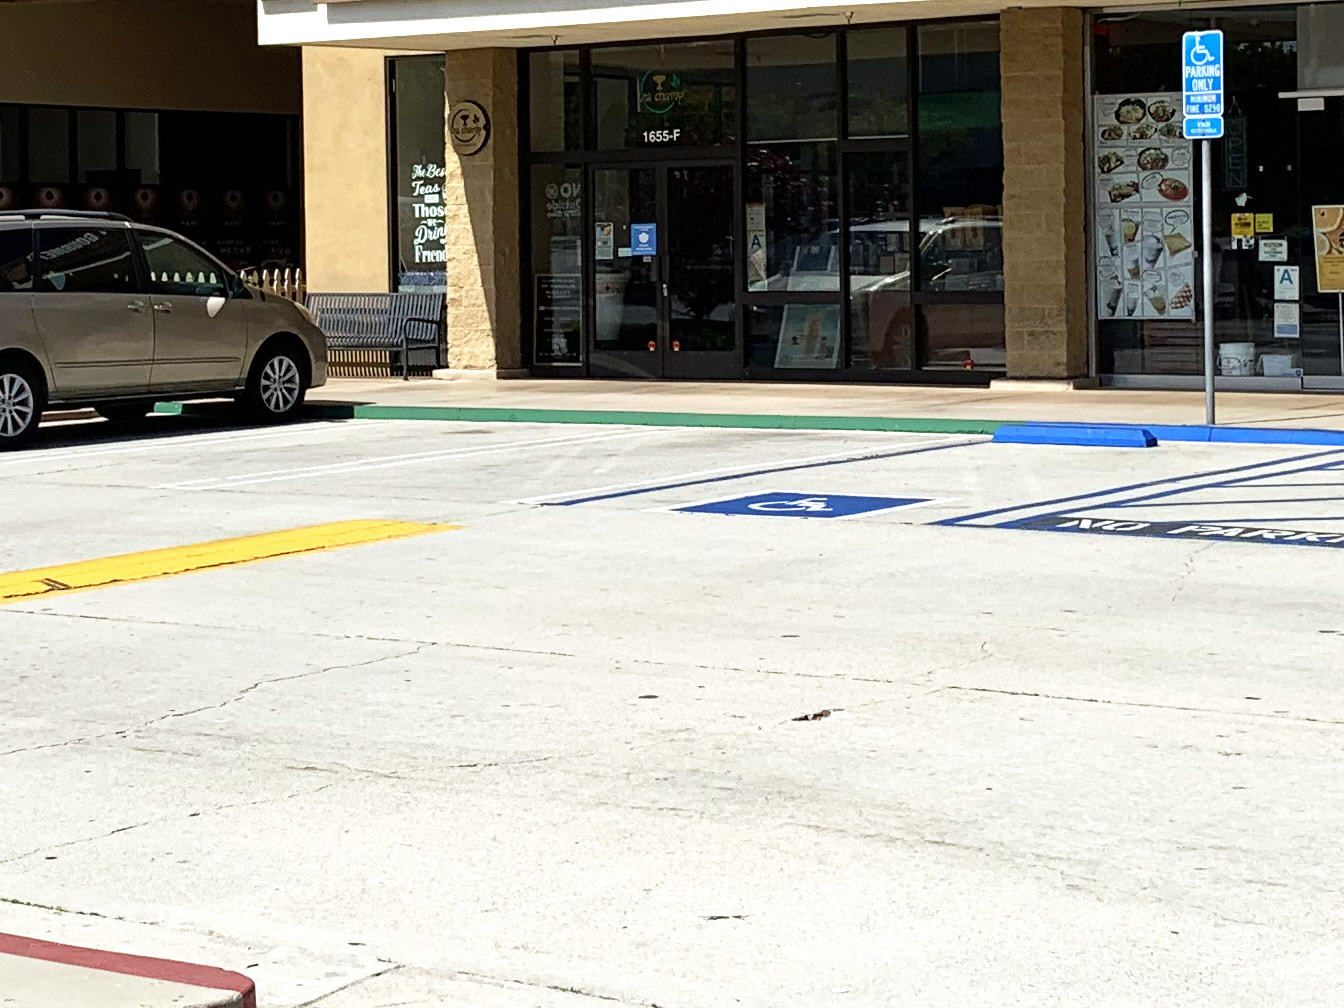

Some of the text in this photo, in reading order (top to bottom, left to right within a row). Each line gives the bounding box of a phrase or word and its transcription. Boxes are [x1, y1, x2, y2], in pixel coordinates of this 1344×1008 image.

[1185, 65, 1221, 78] PARKING
[1191, 79, 1214, 91] ONLY
[642, 129, 681, 143] 1655-F
[412, 164, 425, 179] The
[412, 180, 440, 196] Teas
[751, 234, 762, 248] A
[1279, 268, 1294, 285] A
[1057, 517, 1149, 531] NO
